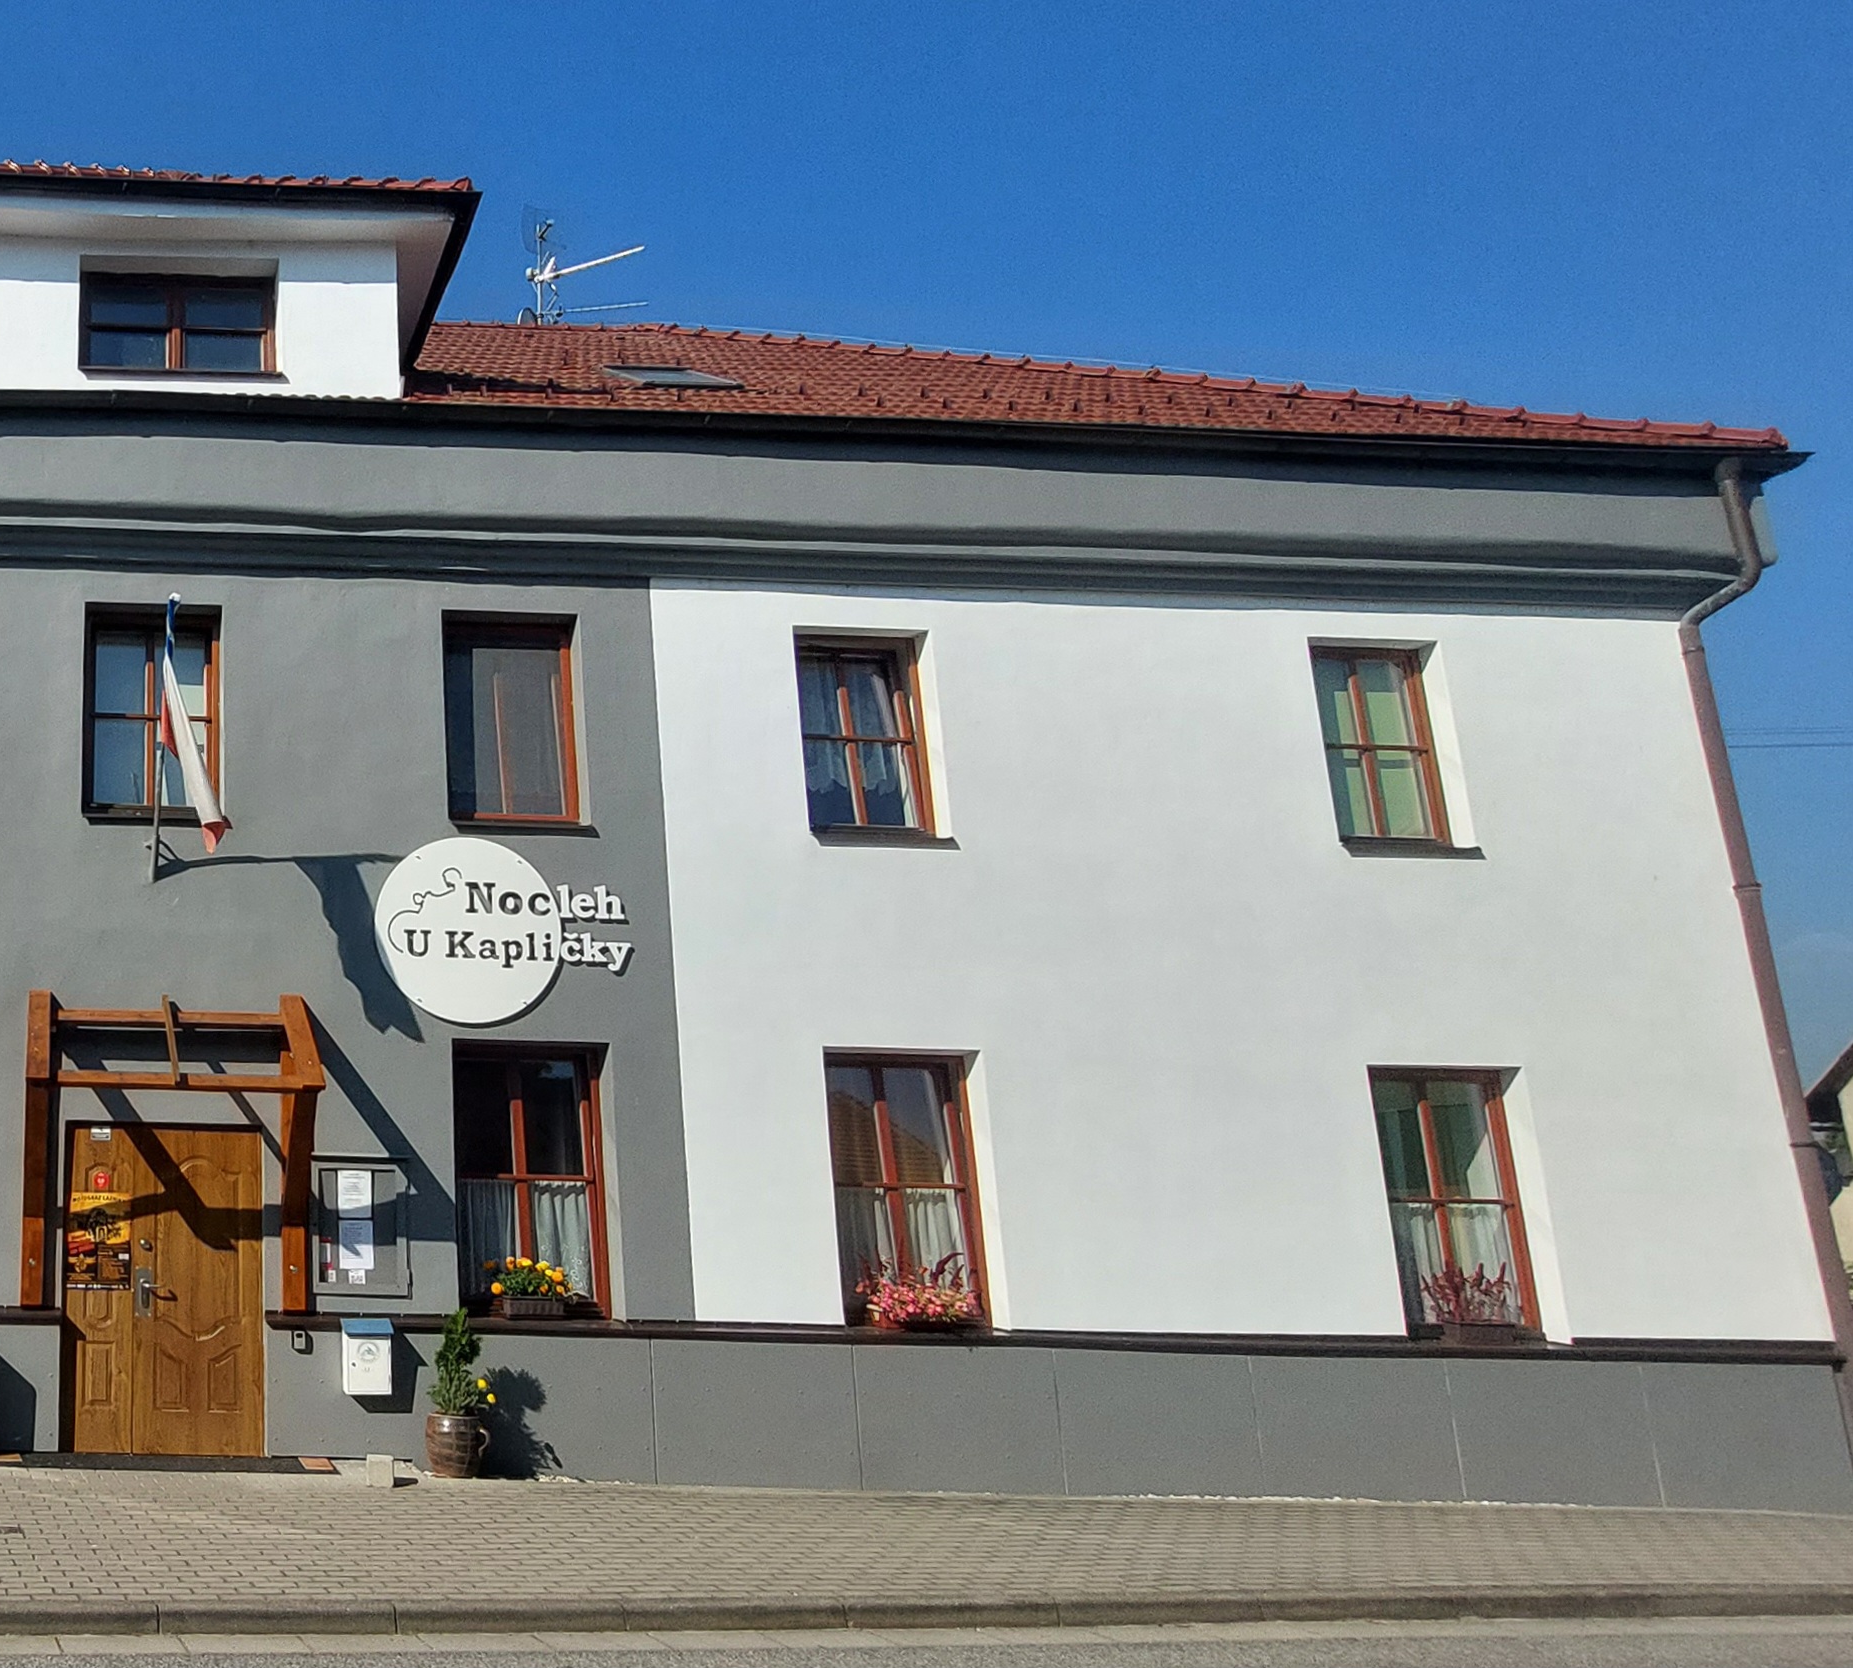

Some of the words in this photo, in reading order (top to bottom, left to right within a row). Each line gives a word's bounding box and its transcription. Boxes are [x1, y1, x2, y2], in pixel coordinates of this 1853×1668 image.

[465, 882, 625, 921] Nocleh
[404, 929, 431, 957] U
[445, 930, 632, 971] Kapličky
